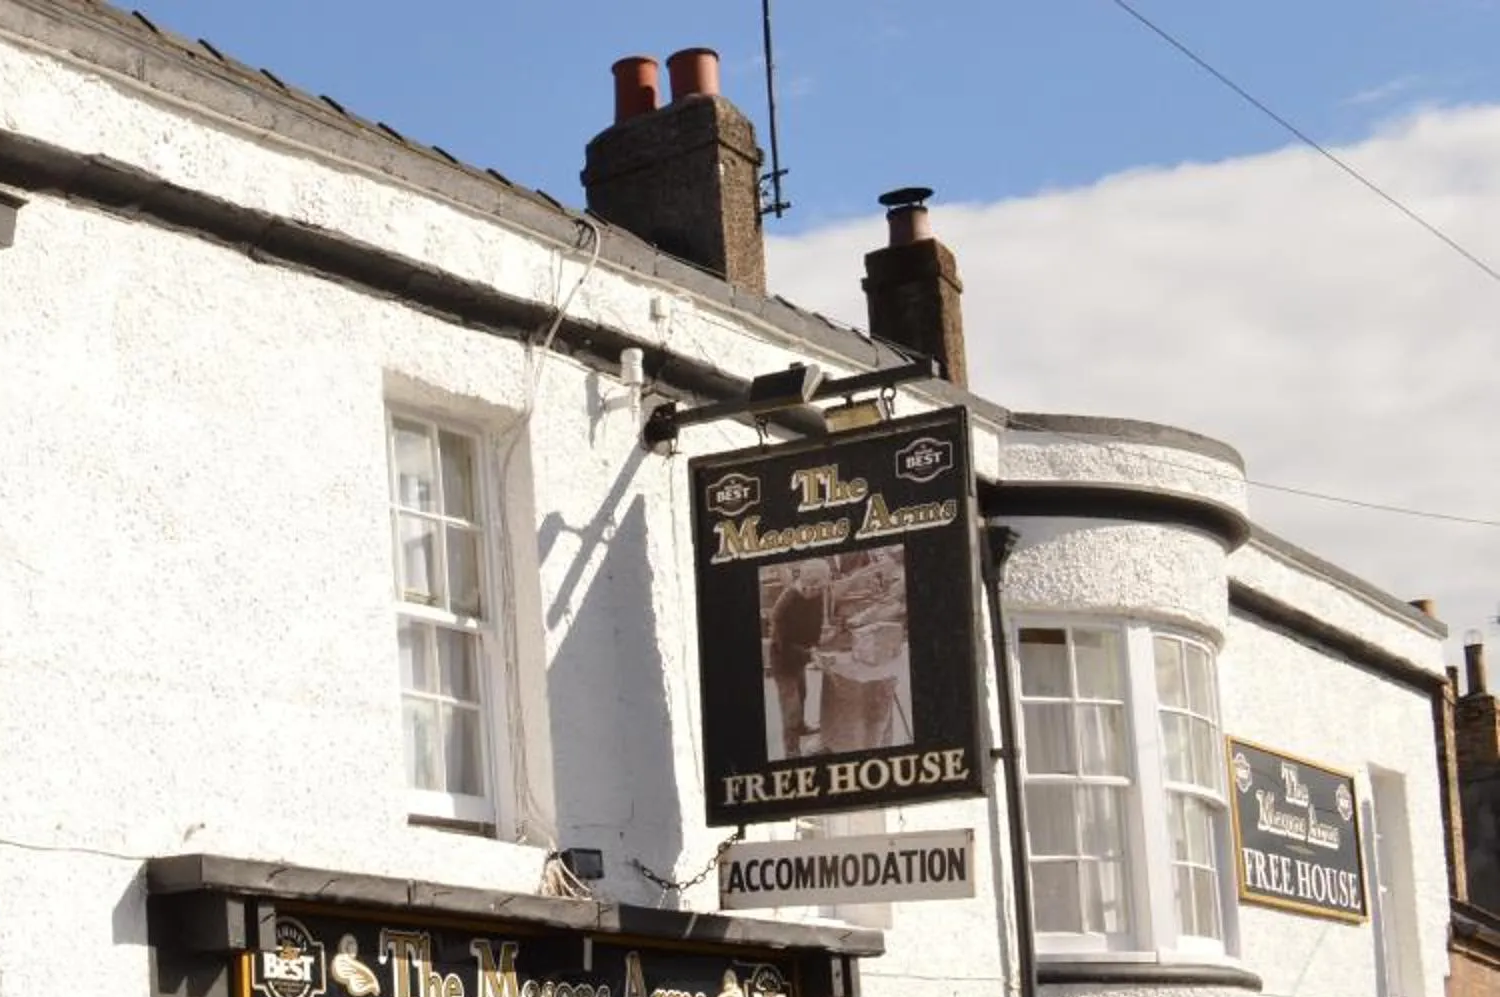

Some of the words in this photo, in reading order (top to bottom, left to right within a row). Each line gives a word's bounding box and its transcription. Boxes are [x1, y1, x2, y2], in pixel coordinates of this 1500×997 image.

[905, 450, 943, 469] BEST
[716, 487, 750, 503] BEST
[790, 463, 868, 512] The
[709, 515, 850, 565] Masons
[855, 493, 958, 541] Arms
[722, 767, 821, 805] FREE
[827, 748, 970, 793] HOUSE
[1281, 761, 1309, 807] The
[726, 848, 966, 894] ACCOMMODATION
[1242, 847, 1295, 896] FREE
[1295, 860, 1361, 909] HOUSE
[263, 954, 315, 981] BEST
